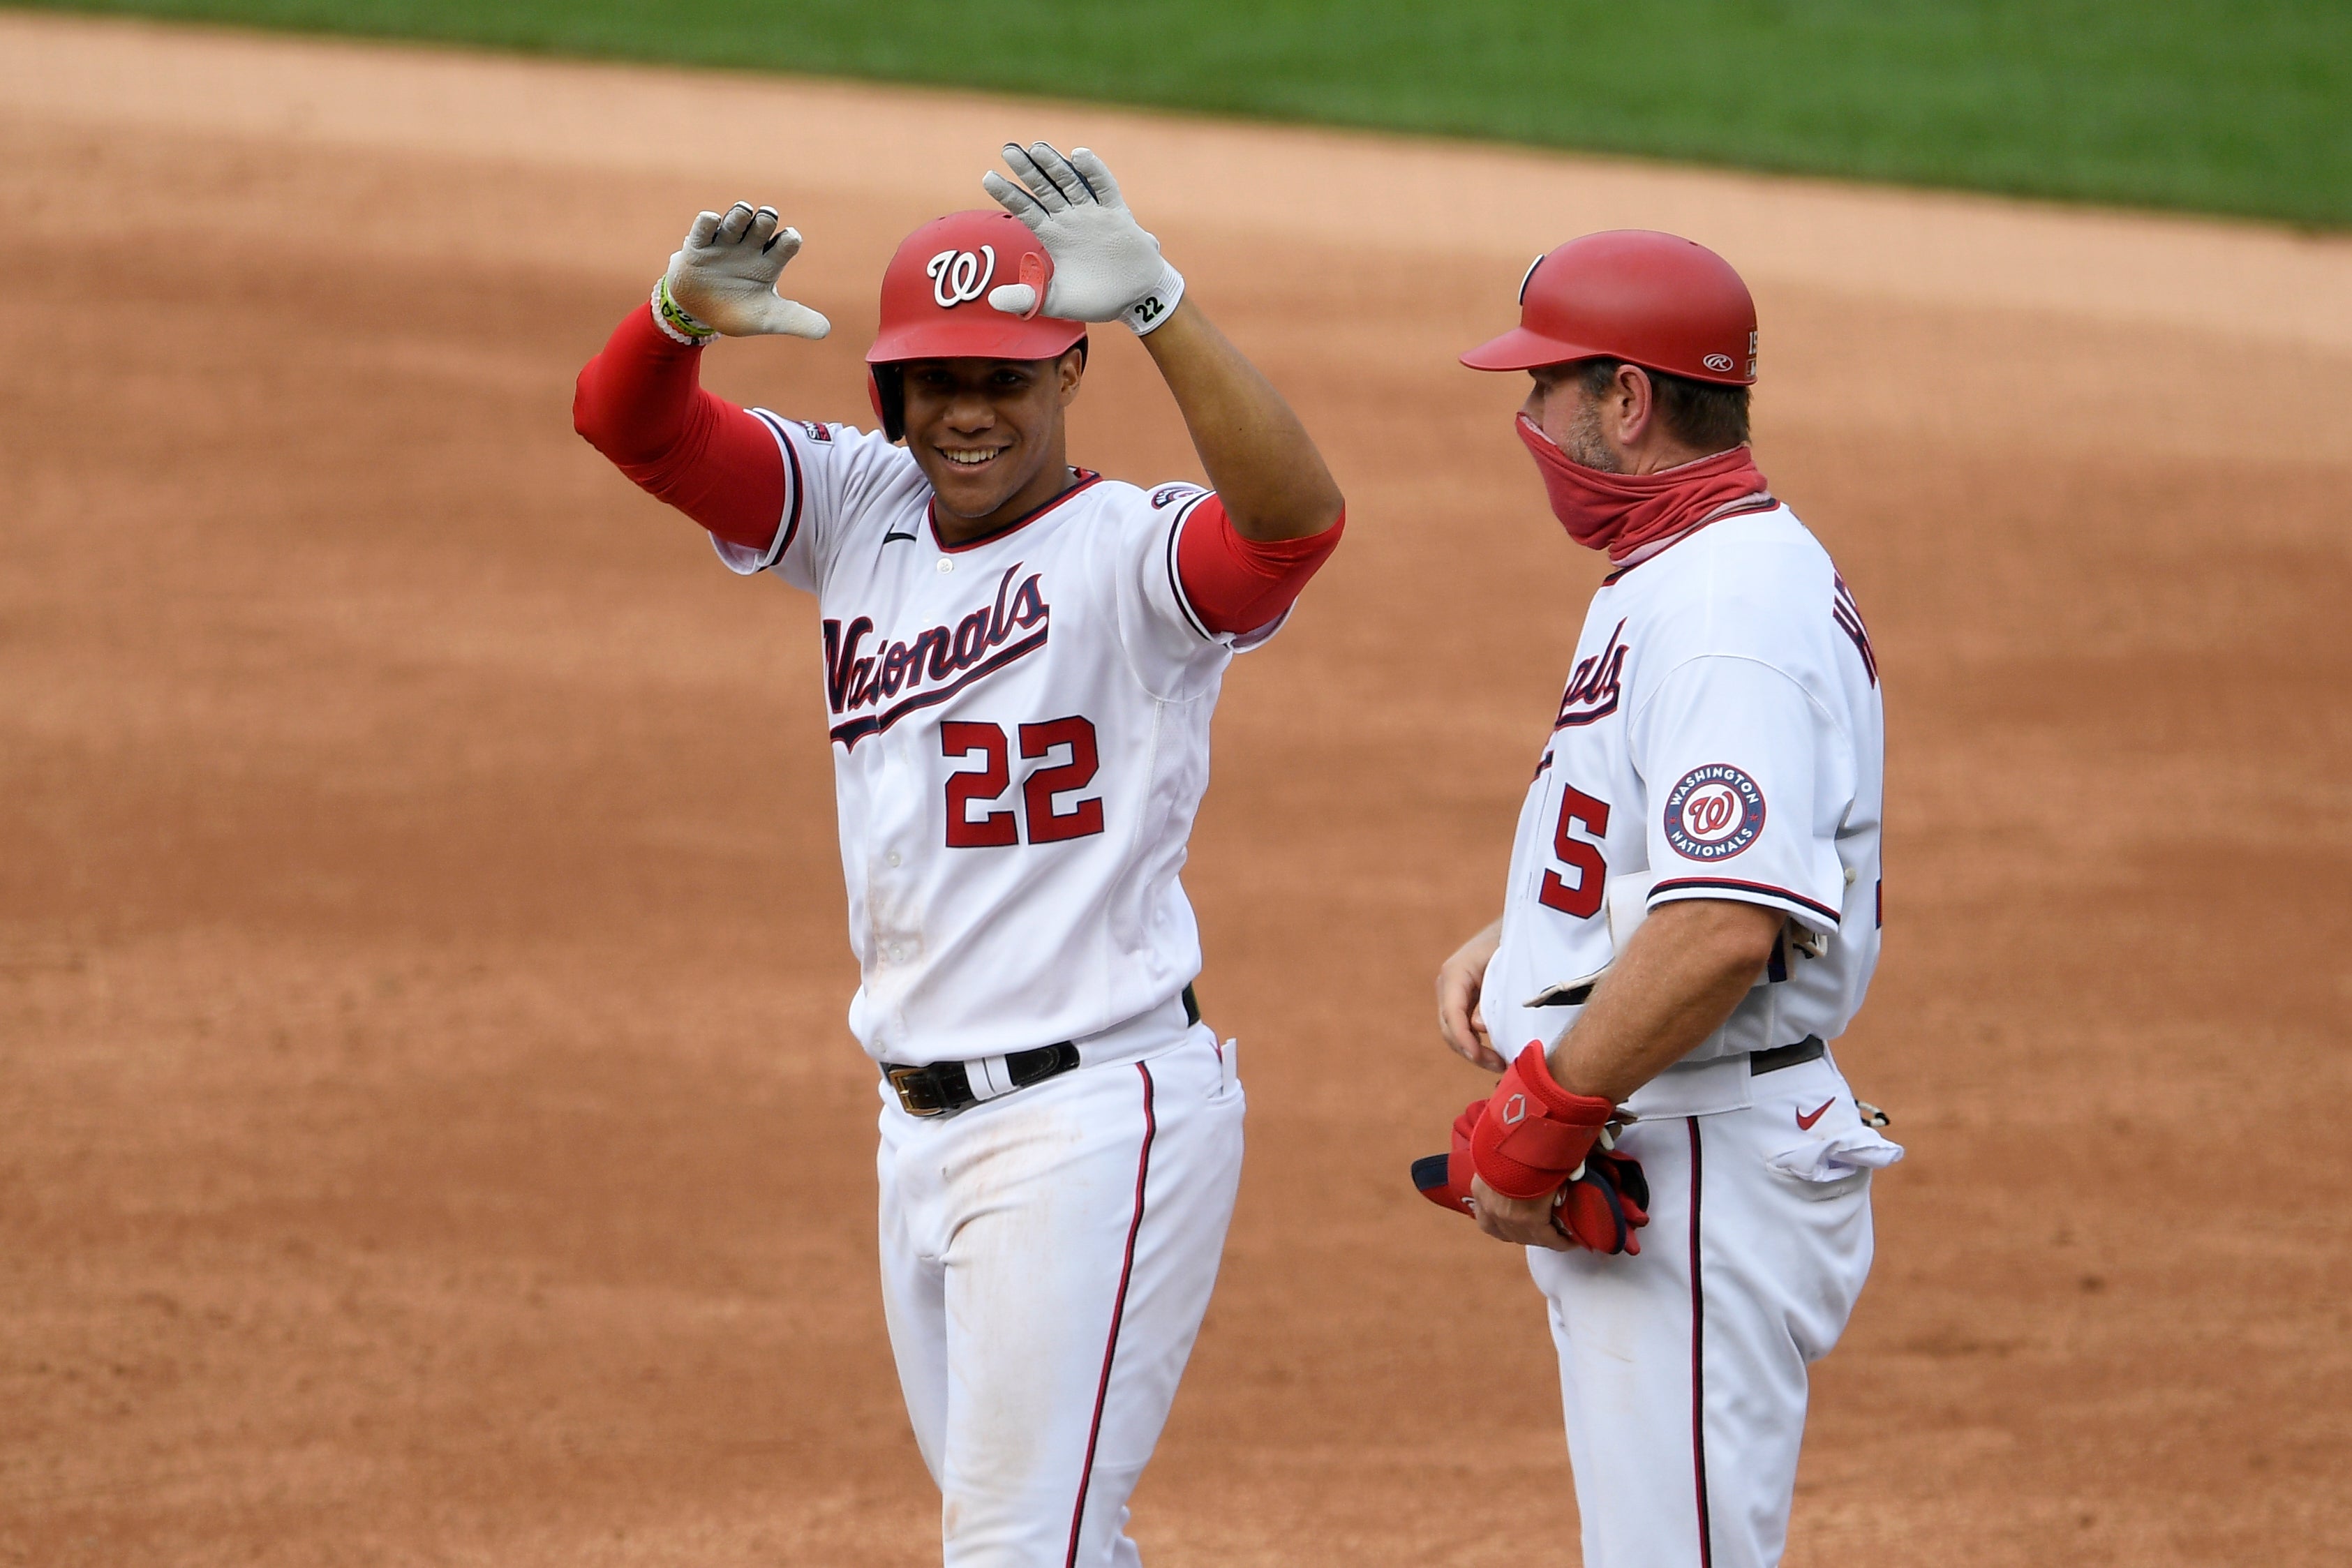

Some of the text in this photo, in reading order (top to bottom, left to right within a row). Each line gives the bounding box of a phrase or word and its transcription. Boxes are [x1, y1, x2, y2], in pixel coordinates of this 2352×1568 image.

[925, 244, 996, 308] W
[1134, 297, 1165, 323] 22
[823, 561, 1050, 719] Naionals
[940, 715, 1105, 849] 22
[1670, 767, 1759, 806] WASHINGTON
[1688, 791, 1734, 835] W
[1539, 782, 1611, 920] 5
[1671, 828, 1753, 857] NATIONALS
